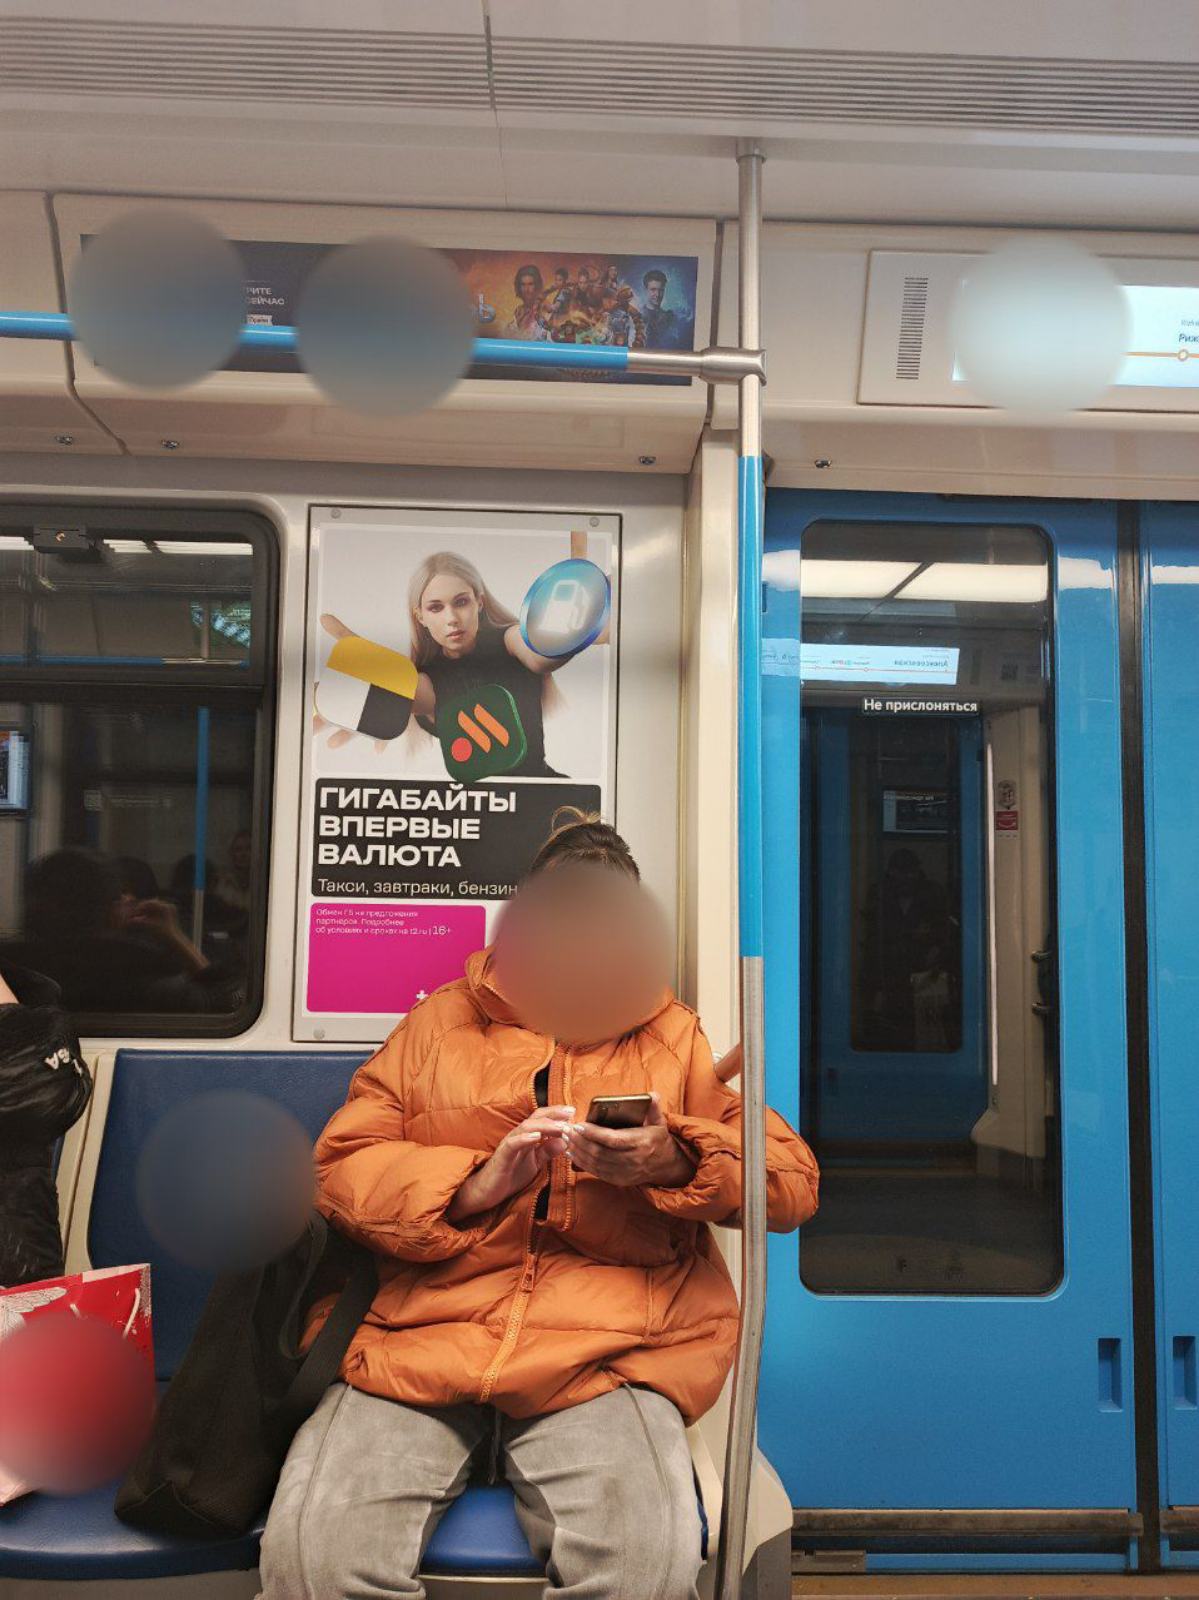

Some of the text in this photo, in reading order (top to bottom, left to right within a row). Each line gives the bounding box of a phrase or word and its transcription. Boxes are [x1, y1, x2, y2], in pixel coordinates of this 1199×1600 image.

[242, 287, 273, 295] РИТЕ
[863, 698, 978, 713] Не прислоняться
[319, 783, 517, 813] ГИГАБАЙТЫ
[318, 814, 481, 840] ВПЕРВЫЕ
[317, 843, 462, 868] ВАЛЮТА
[317, 878, 518, 897] Такси, завтраки, бензин
[316, 908, 343, 916] Обмен
